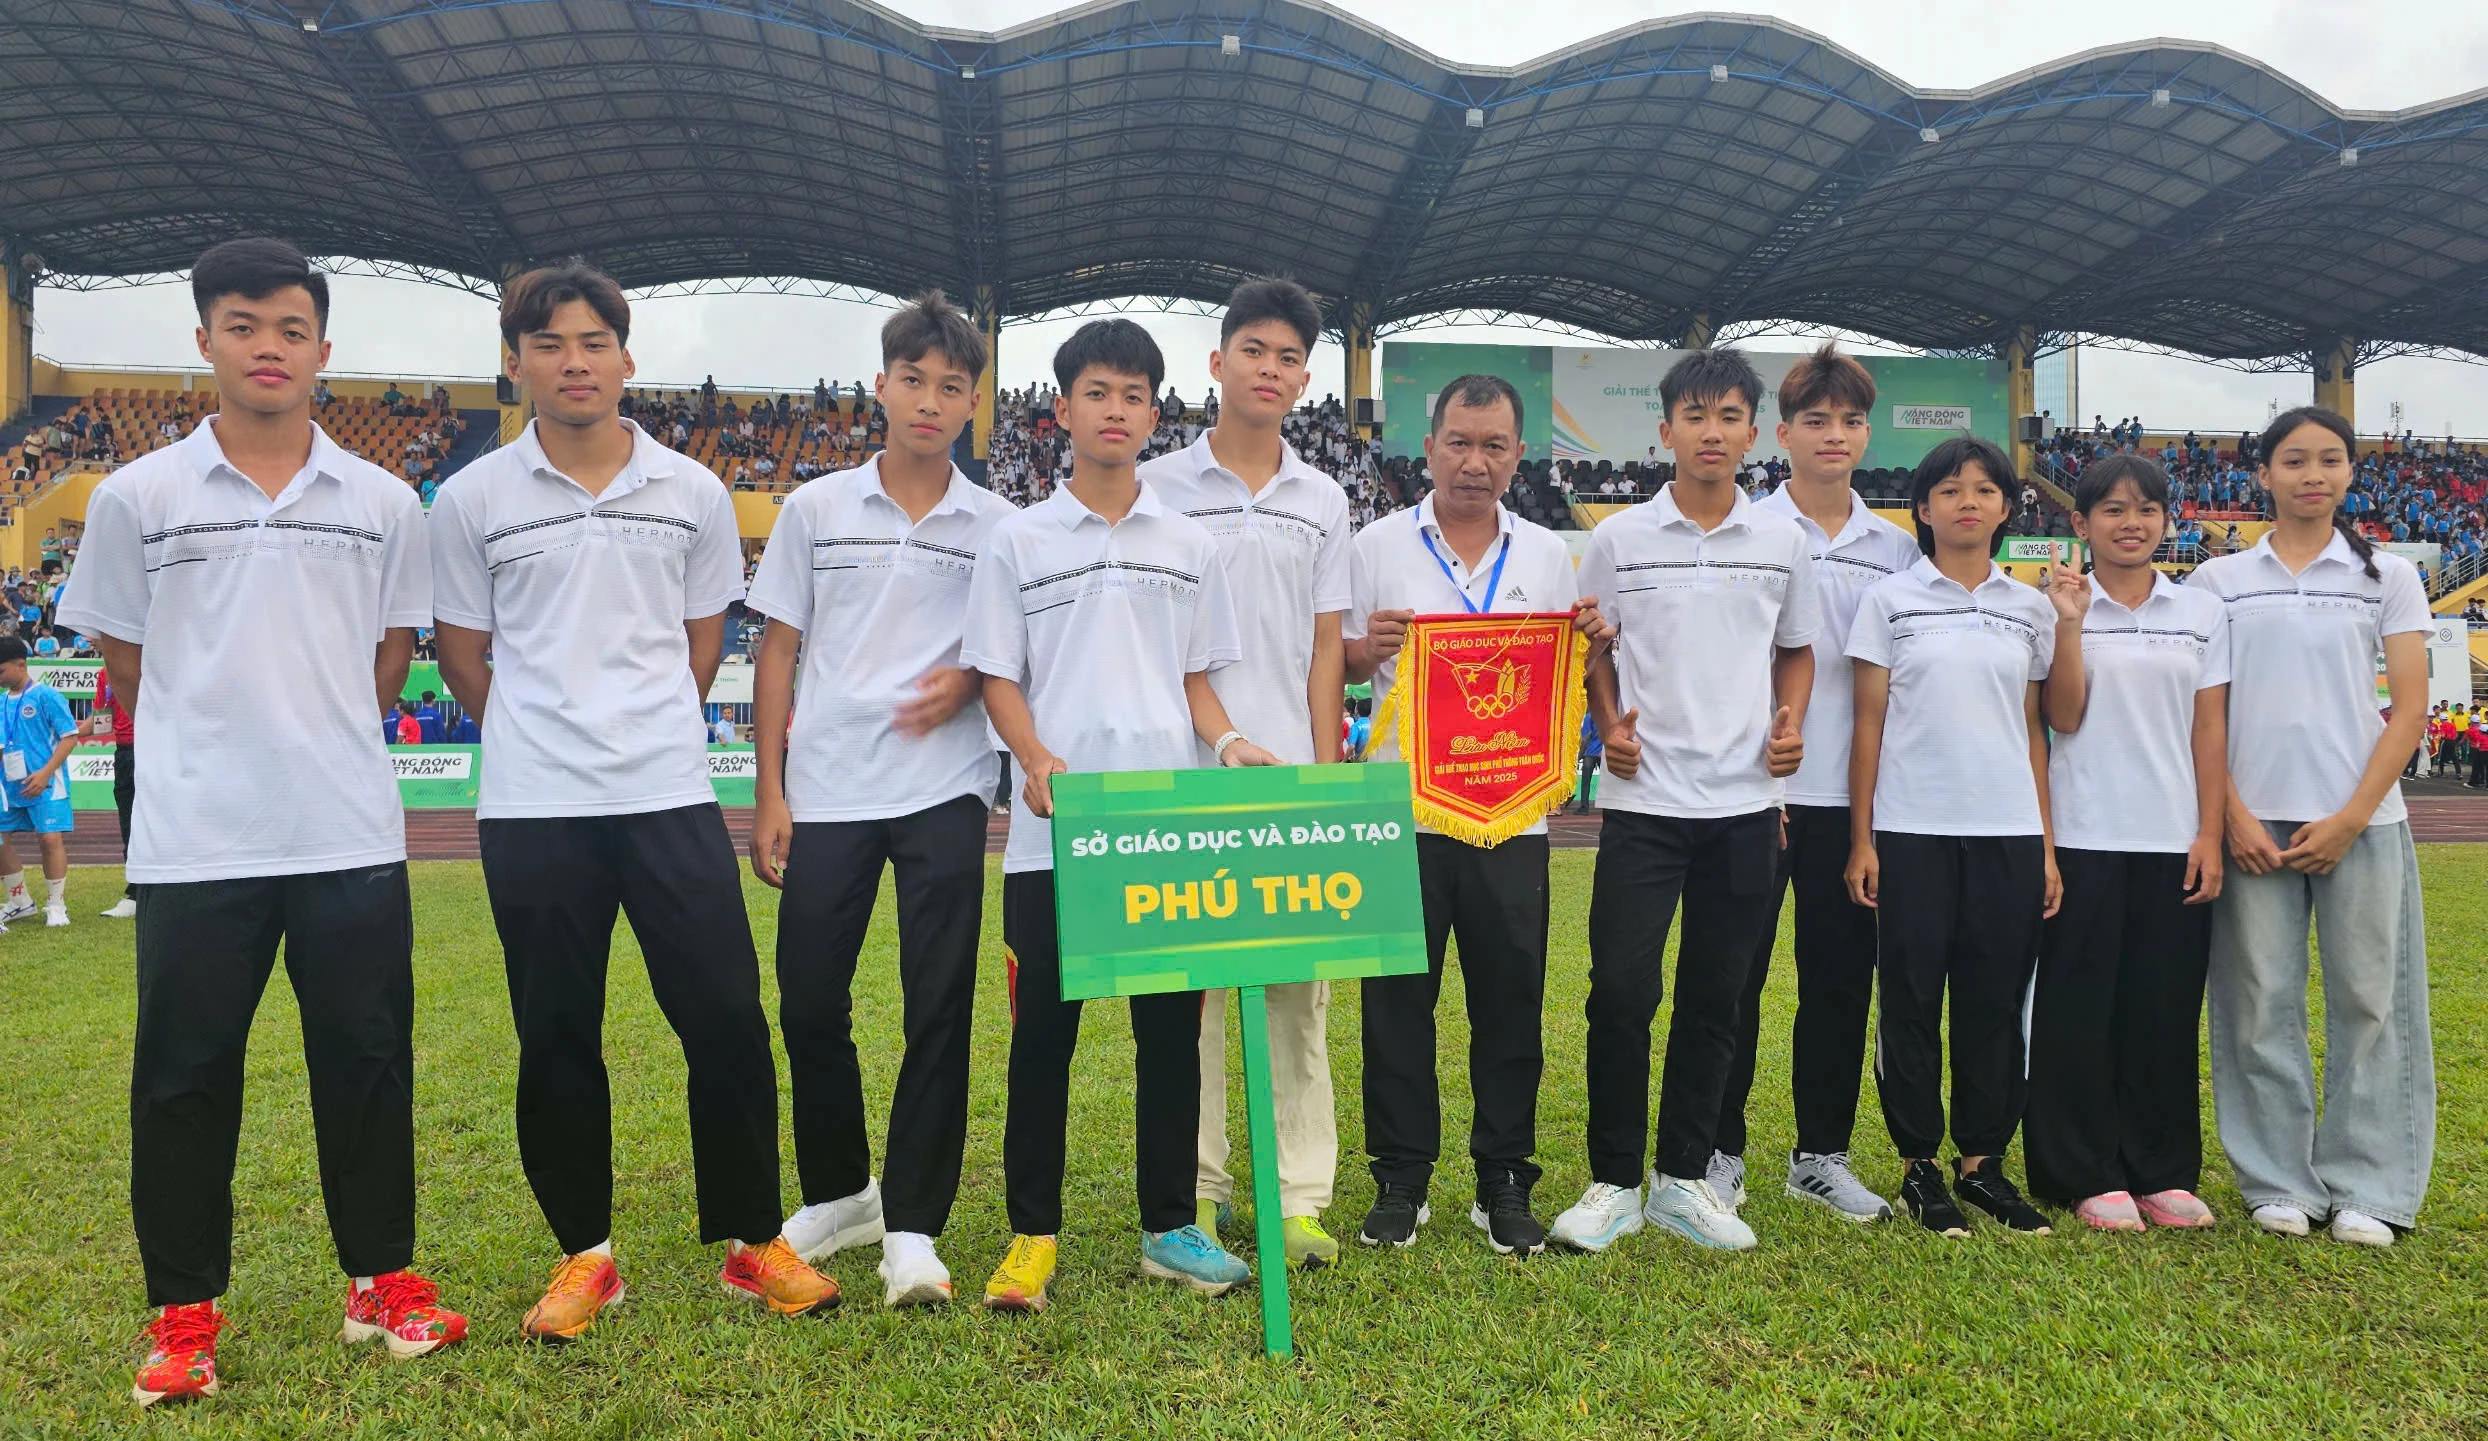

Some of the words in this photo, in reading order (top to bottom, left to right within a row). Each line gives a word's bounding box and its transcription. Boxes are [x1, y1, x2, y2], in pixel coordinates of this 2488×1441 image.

[1433, 641, 1448, 653] BỘ
[1450, 637, 1473, 649] GIÁO
[1475, 638, 1497, 648] DỤC
[1512, 634, 1533, 645] ĐÀO
[1536, 633, 1554, 645] TẠO
[75, 679, 98, 688] NA
[411, 766, 445, 774] NAM
[712, 764, 743, 773] NAM
[1464, 775, 1491, 785] NĂM
[1494, 772, 1518, 782] 2025
[1072, 829, 1109, 857] SỞ
[1116, 828, 1182, 854] GIÁO
[1188, 829, 1243, 854] DỤC
[1248, 823, 1285, 847] VÀ
[1290, 820, 1346, 844] ĐÀO
[1351, 821, 1400, 846] TẠO
[1125, 868, 1239, 924] PHÚ
[1252, 871, 1363, 920] THỌ
